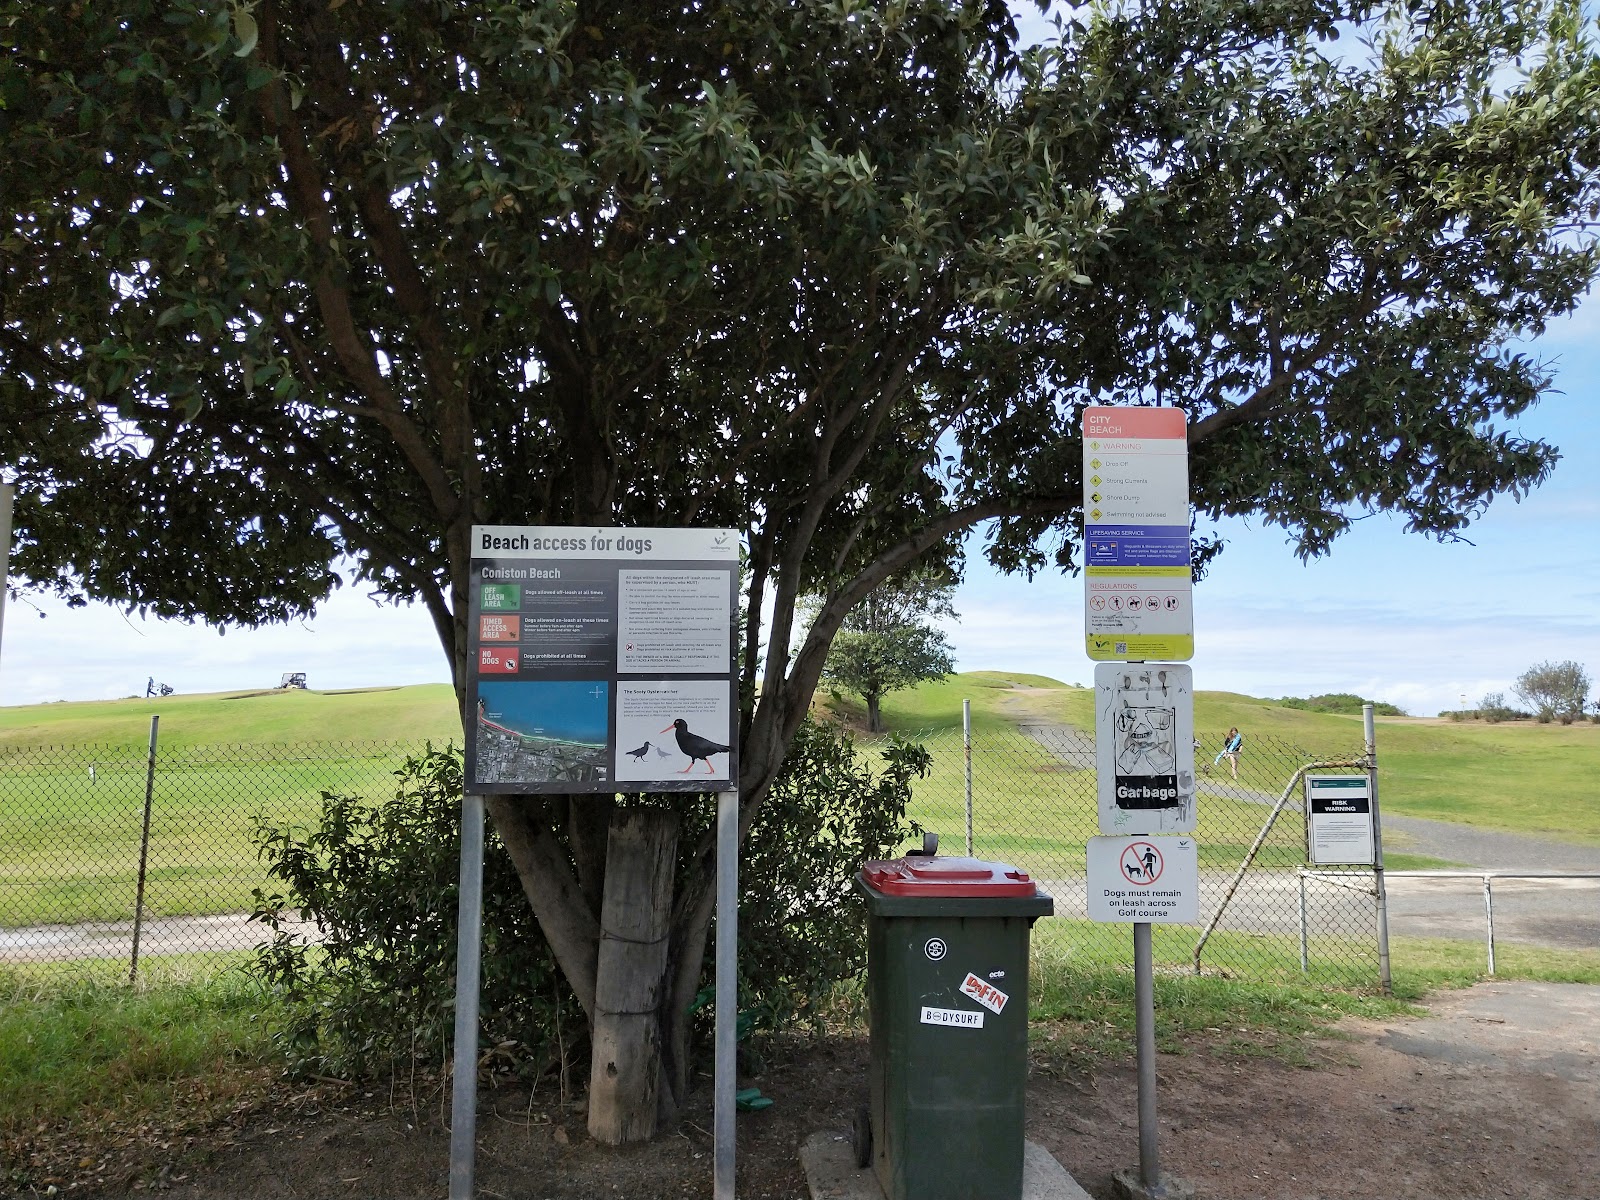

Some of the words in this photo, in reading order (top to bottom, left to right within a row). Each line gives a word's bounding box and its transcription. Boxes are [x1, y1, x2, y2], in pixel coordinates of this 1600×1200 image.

[1089, 416, 1111, 424] CITY
[1090, 426, 1122, 434] BEACH
[482, 534, 528, 550] Beach
[533, 538, 587, 550] access
[591, 535, 612, 551] for
[616, 535, 652, 554] dogs
[481, 567, 527, 578] Coniston
[530, 567, 560, 578] Beach
[1117, 786, 1176, 800] Garbage
[1104, 890, 1126, 898] Dogs
[1152, 889, 1182, 897] remain
[1118, 909, 1136, 917] Golf
[926, 1011, 978, 1024] BODYSURF
